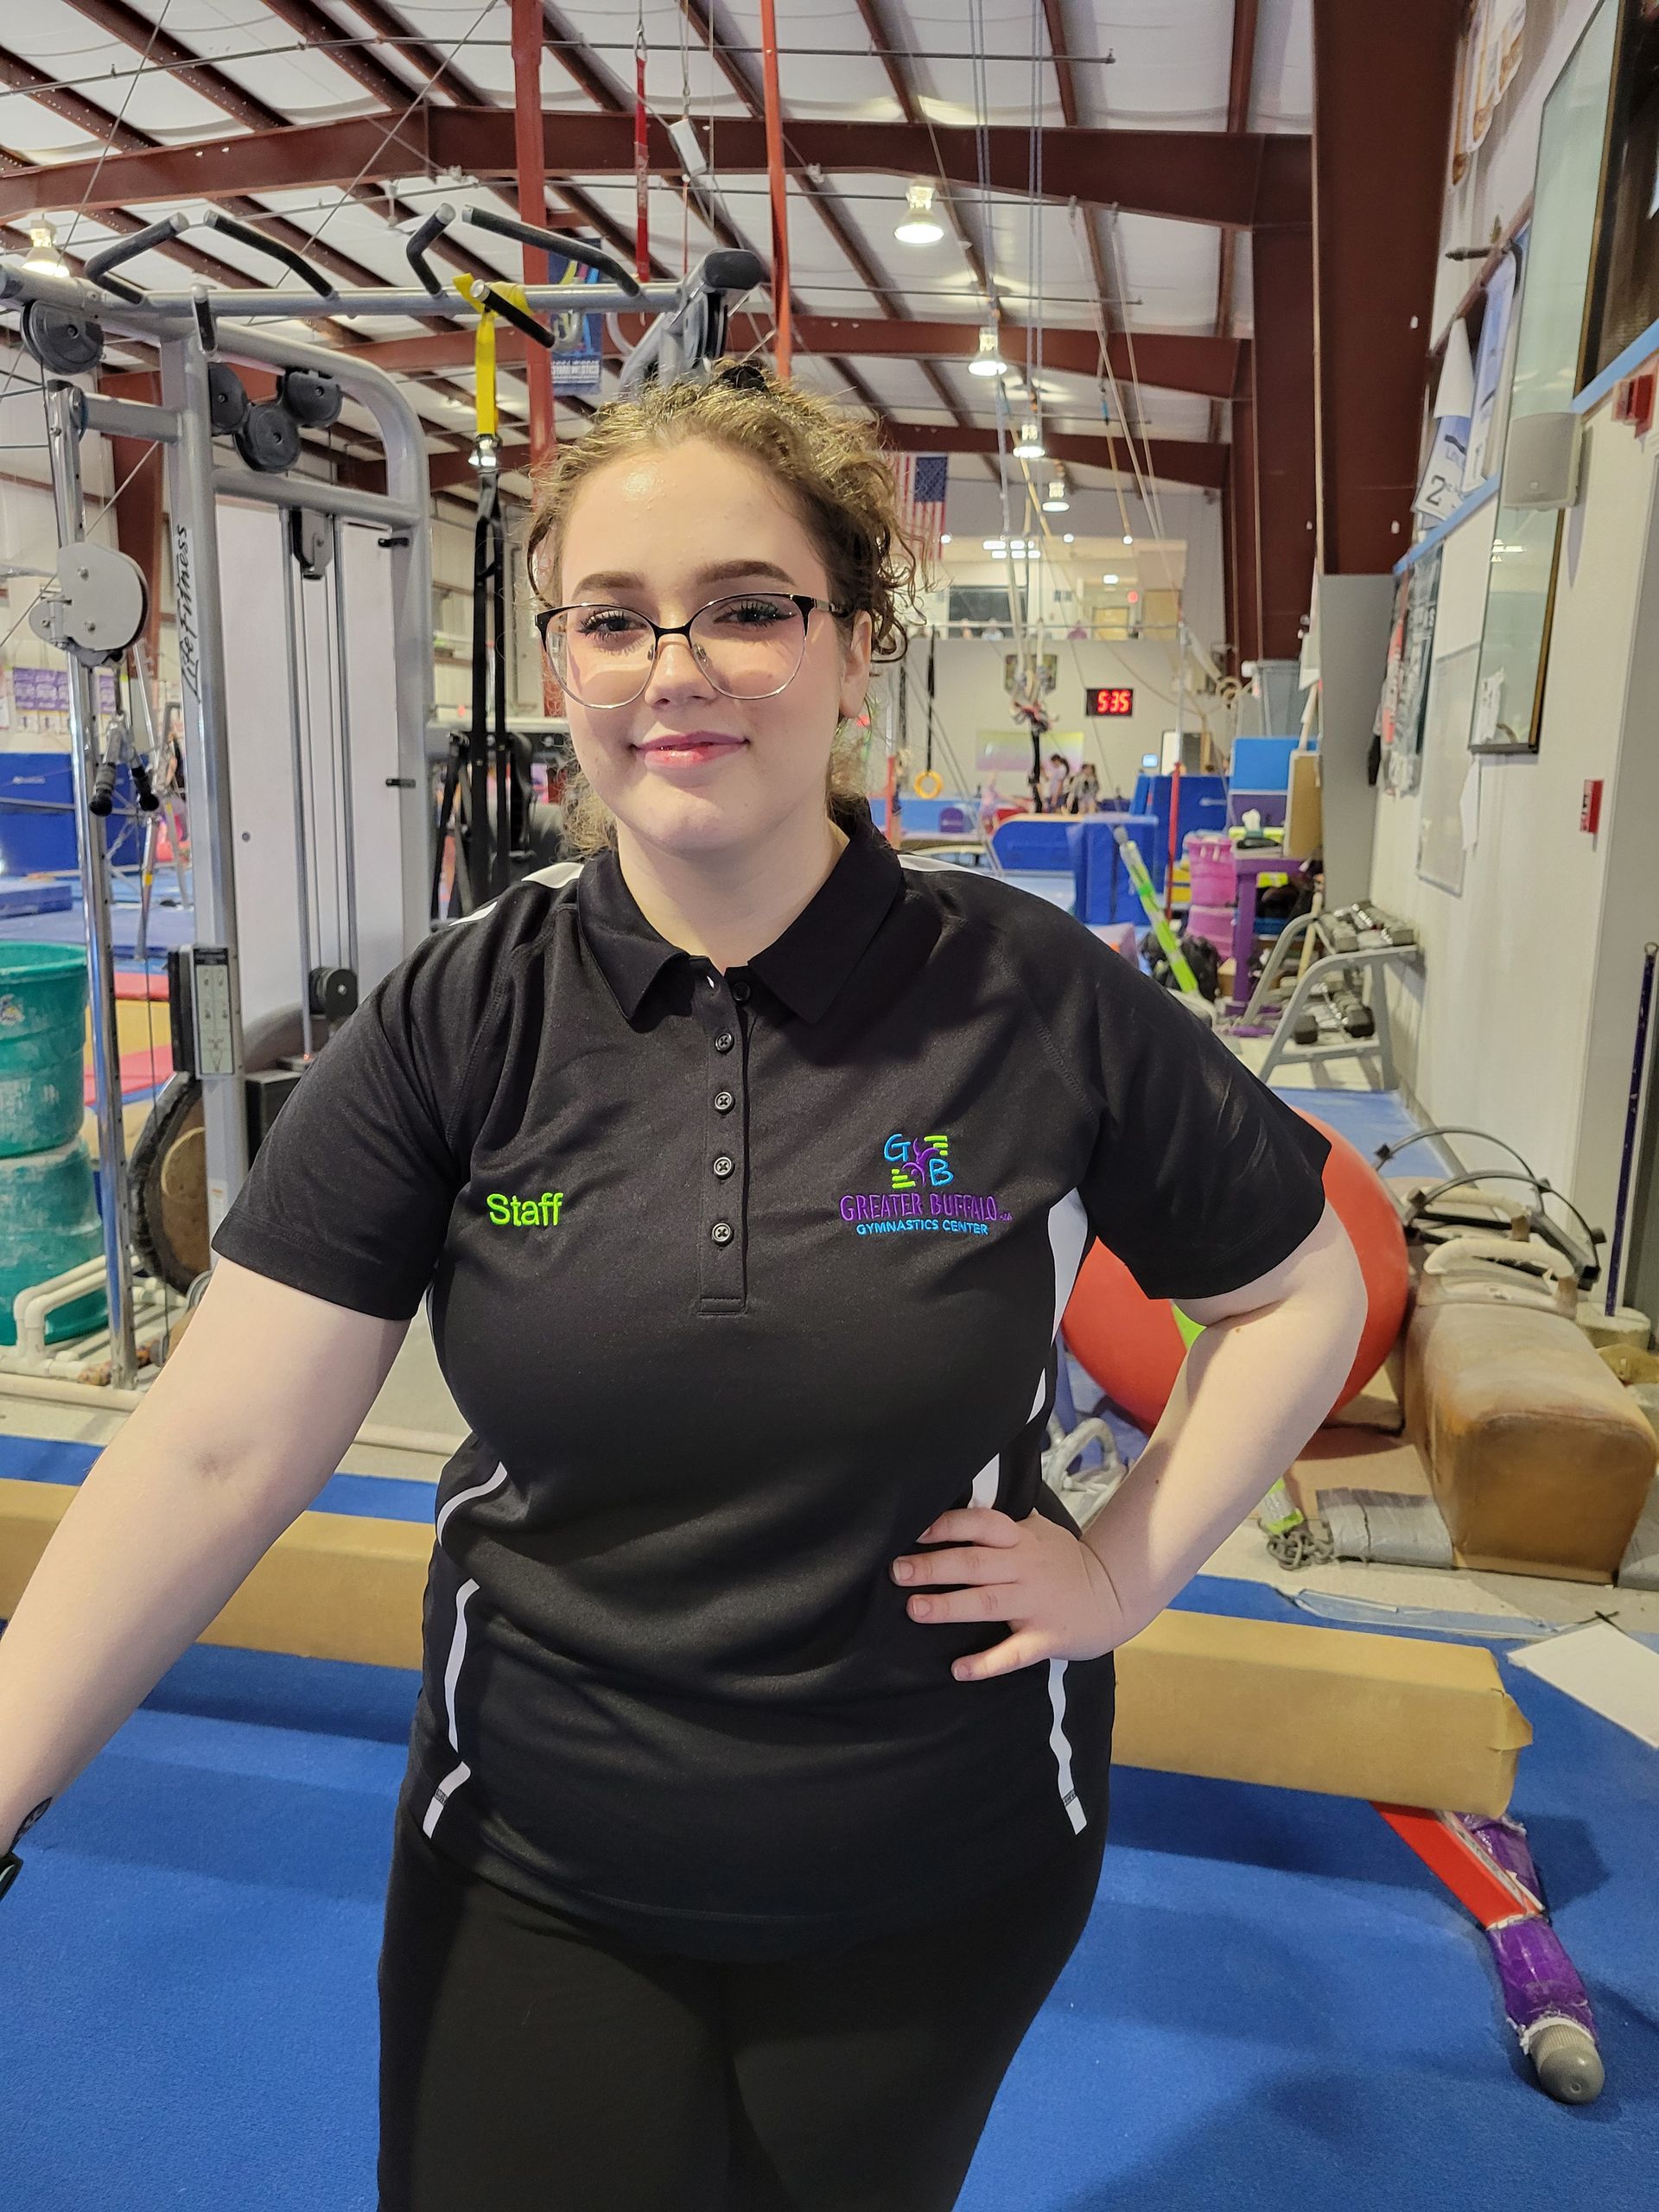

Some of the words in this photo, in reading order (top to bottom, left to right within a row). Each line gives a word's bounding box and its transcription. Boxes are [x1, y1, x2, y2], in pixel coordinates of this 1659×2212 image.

[486, 1192, 563, 1226] Staff
[839, 1193, 922, 1221] GREATER
[929, 1193, 998, 1221] BUFFALO
[856, 1219, 939, 1236] GYMNASTICS
[942, 1219, 988, 1236] CENTER
